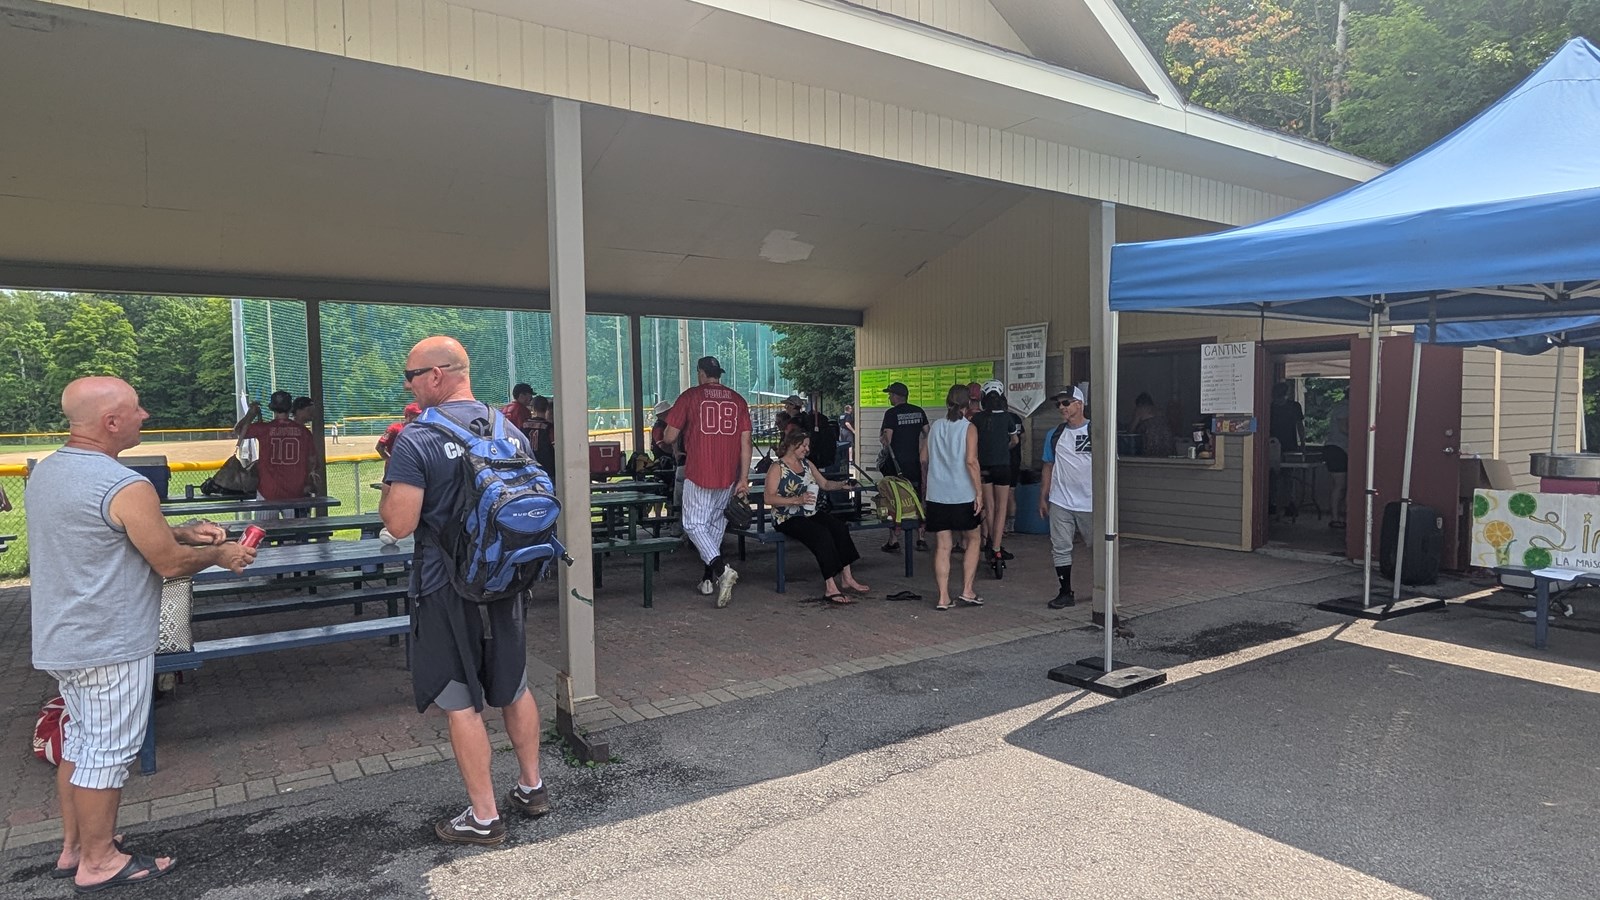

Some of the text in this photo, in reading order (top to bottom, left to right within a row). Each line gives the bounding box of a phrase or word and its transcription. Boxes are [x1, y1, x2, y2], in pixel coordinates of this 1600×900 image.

[1204, 344, 1248, 357] CANTINE
[1009, 382, 1043, 392] CHAMPIONS
[700, 400, 738, 435] 08
[270, 437, 300, 465] 10
[1556, 558, 1570, 566] LA
